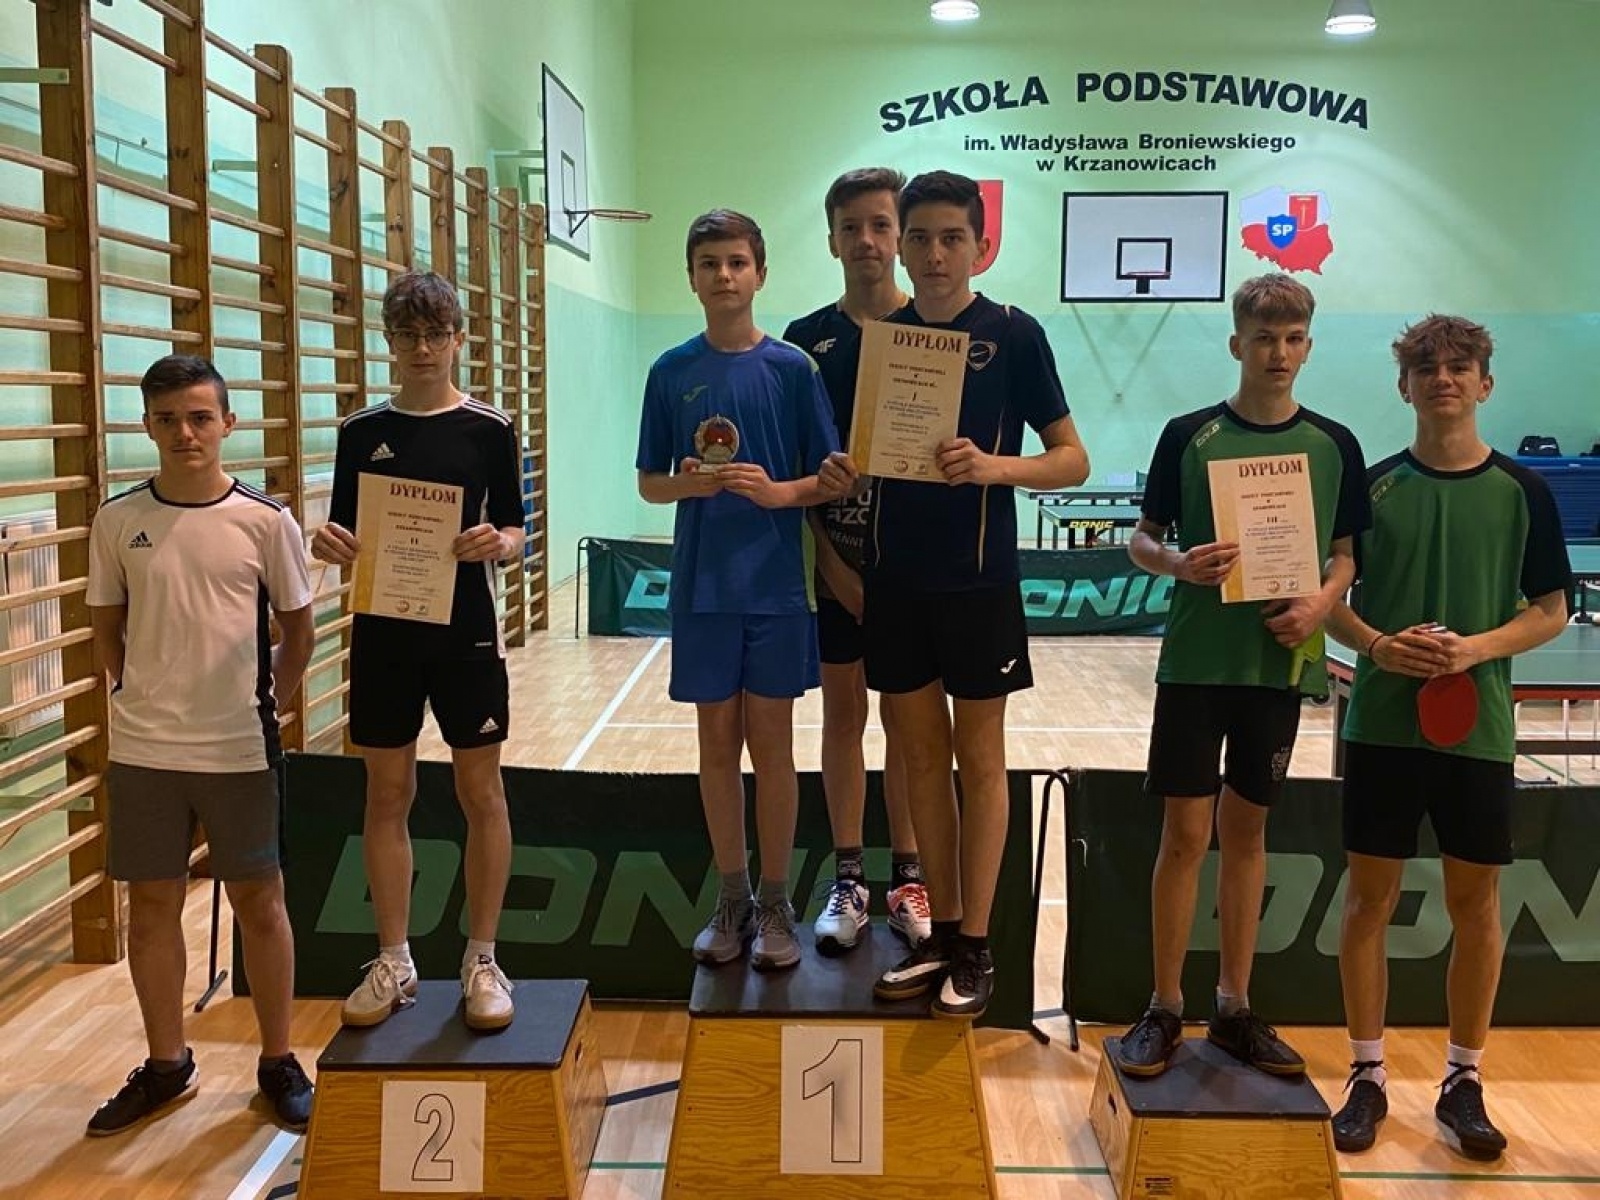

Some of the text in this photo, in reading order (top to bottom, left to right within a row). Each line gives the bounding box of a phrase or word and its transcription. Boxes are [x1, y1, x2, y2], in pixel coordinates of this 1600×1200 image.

[879, 71, 1369, 133] SZKOŁA PODSTAWOWA
[964, 133, 1296, 154] im. Władysława Broniewskiego
[1035, 154, 1217, 172] w Krzanowicach
[1271, 224, 1293, 236] SP
[812, 337, 837, 353] 4F
[893, 329, 962, 354] DYPLOM
[1238, 460, 1303, 478] DYPLOM
[389, 482, 457, 504] DYPLOM
[1068, 520, 1114, 529] DONIC
[802, 1038, 863, 1164] 1
[411, 1093, 455, 1182] 2
